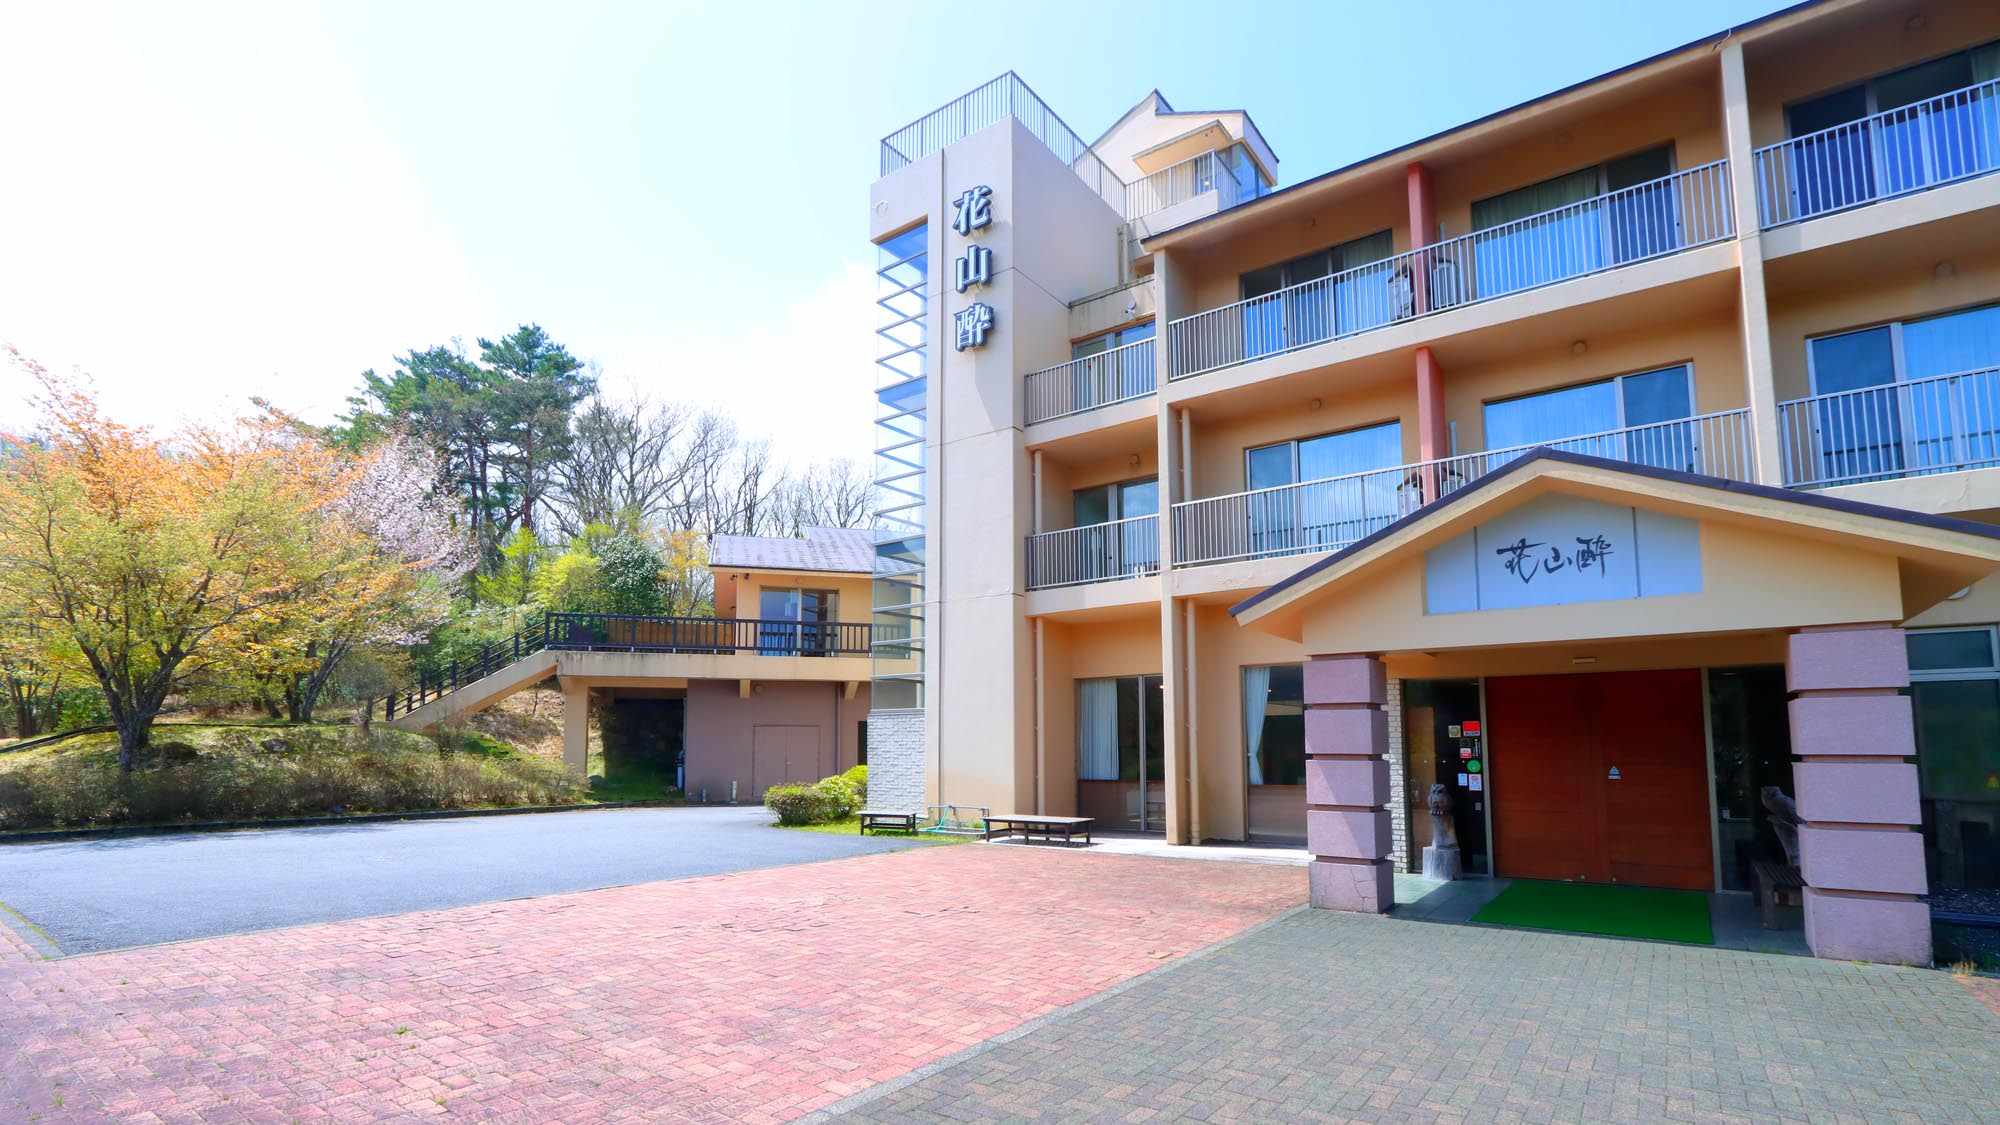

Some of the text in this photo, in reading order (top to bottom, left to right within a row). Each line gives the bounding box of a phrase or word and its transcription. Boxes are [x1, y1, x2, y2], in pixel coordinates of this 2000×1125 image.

[953, 185, 993, 352] 花山酔
[1496, 534, 1614, 583] 花山酔
